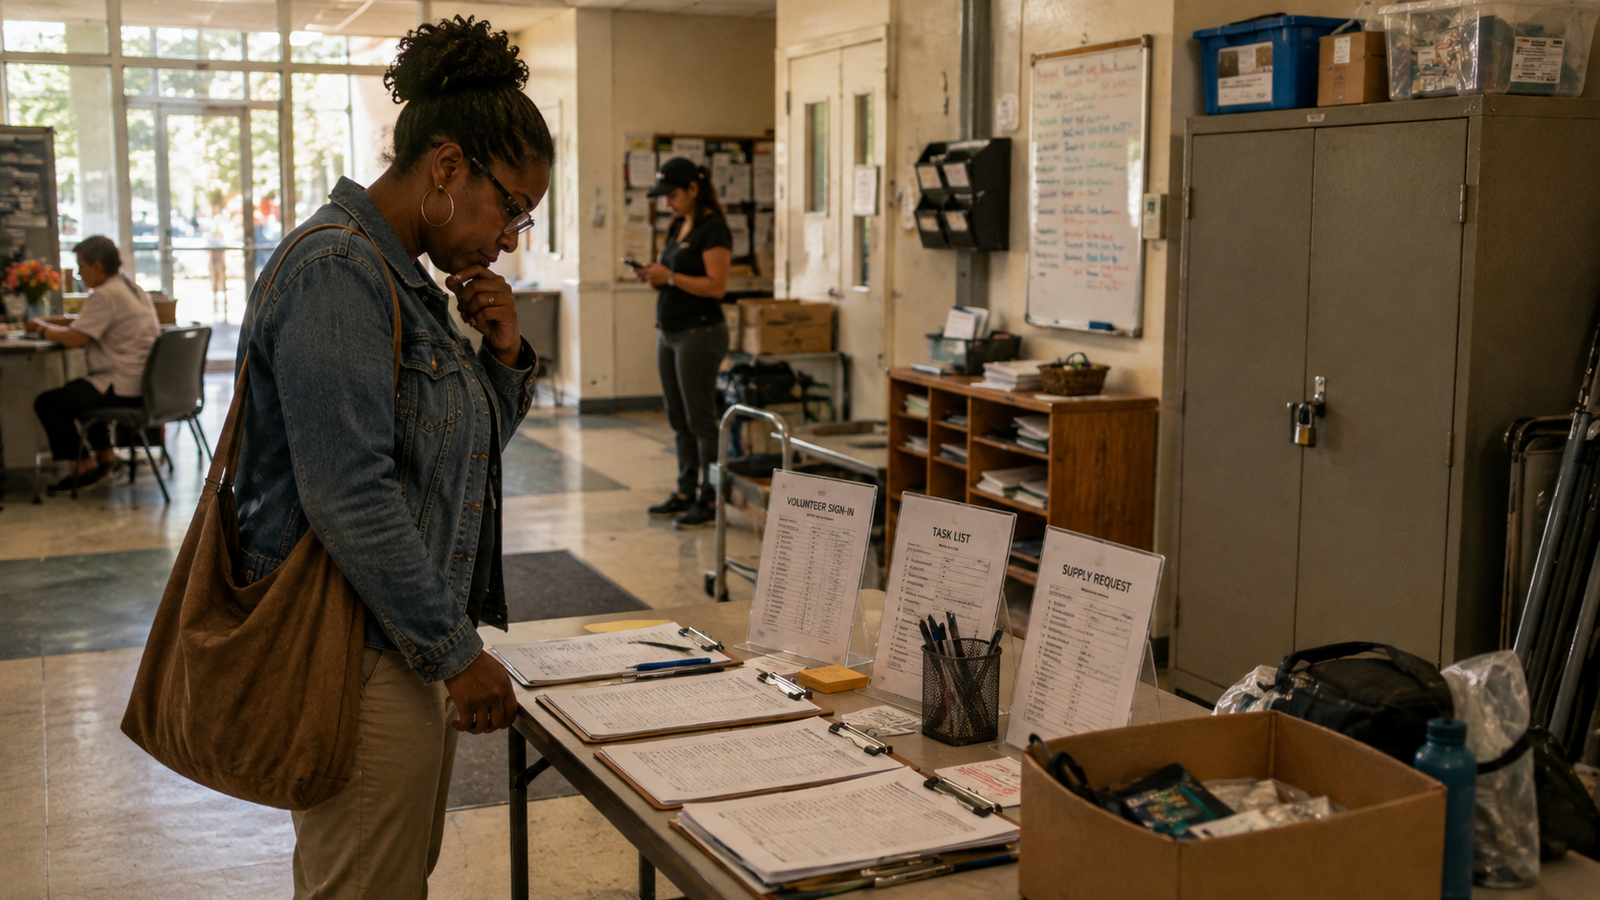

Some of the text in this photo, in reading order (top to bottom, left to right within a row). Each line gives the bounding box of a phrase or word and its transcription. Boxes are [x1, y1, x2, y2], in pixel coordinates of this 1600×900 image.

[787, 497, 855, 516] VOLUNTEER SIGN-IN
[932, 527, 971, 543] TASK LIST
[1062, 564, 1093, 582] SUPPLY
[1093, 573, 1132, 593] REQUEST
